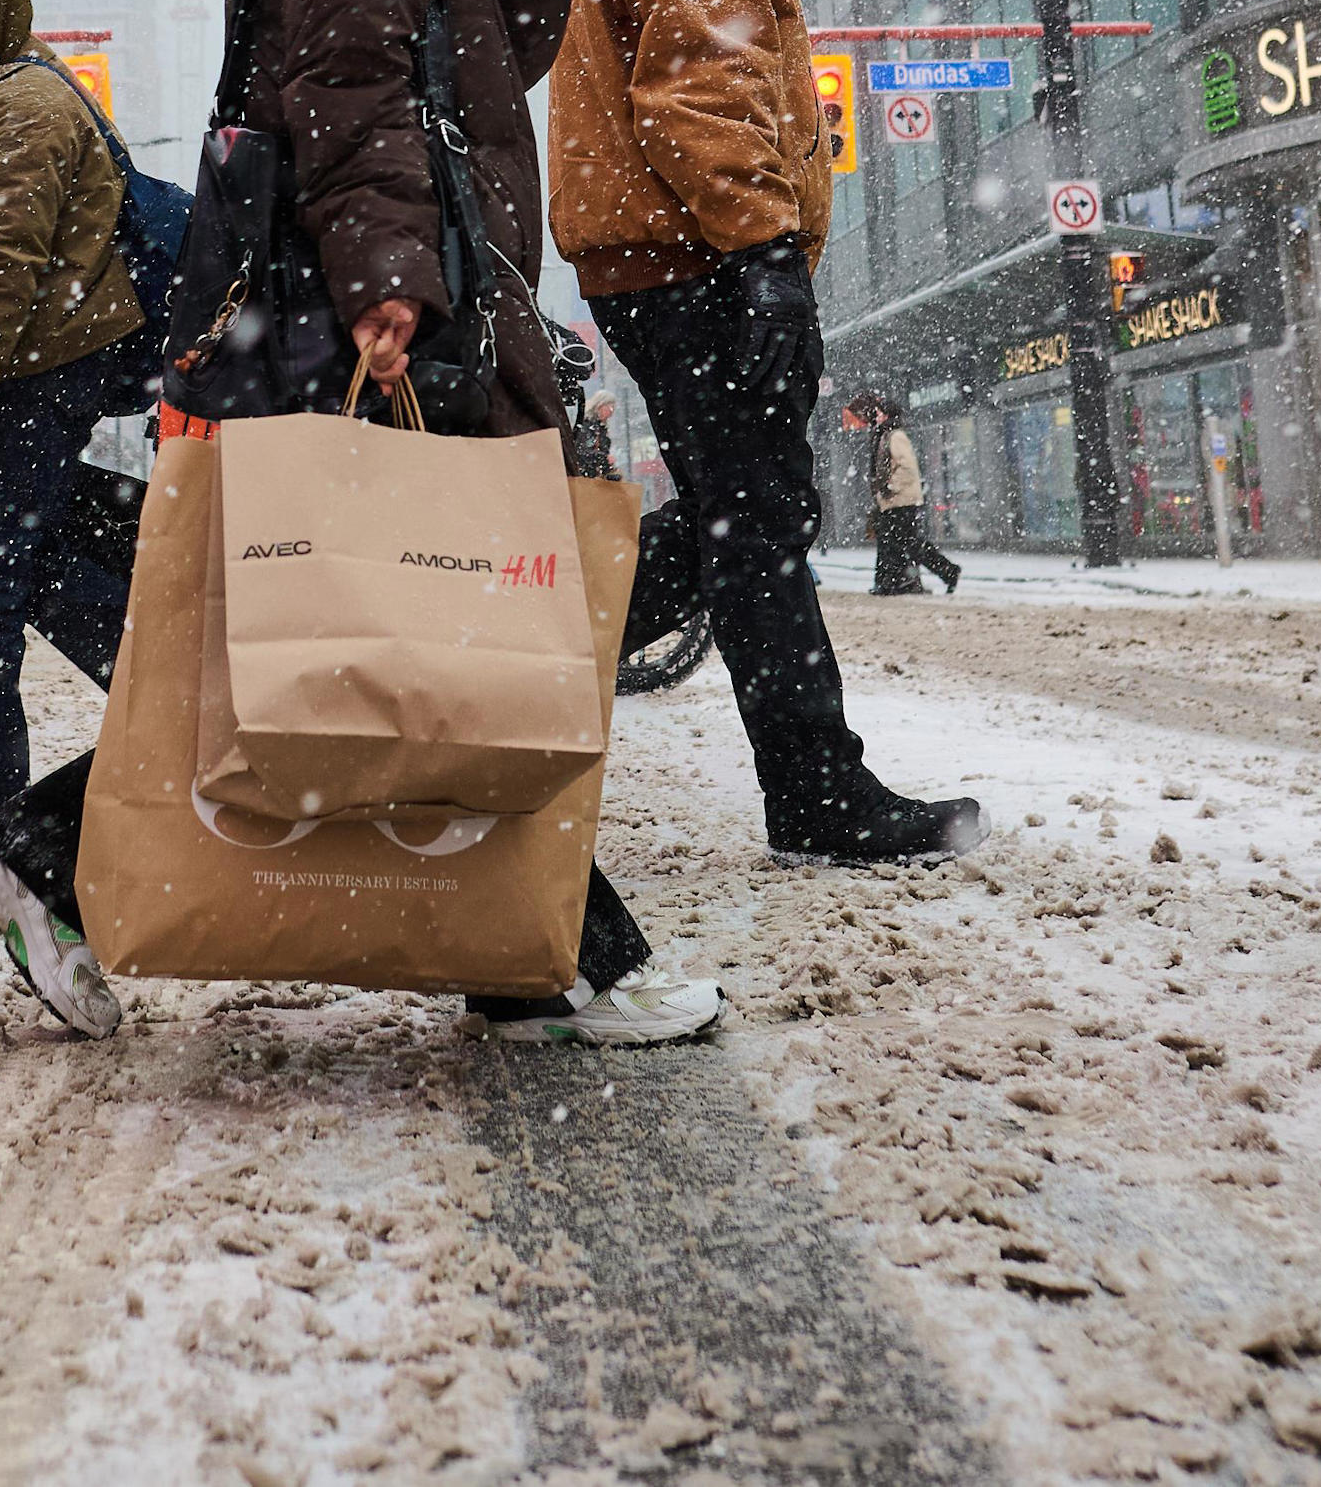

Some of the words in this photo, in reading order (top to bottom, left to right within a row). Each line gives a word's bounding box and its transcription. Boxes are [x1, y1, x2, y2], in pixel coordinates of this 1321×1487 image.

[893, 63, 970, 86] Dundas
[1128, 301, 1173, 348] SHAKE
[1171, 287, 1221, 337] SHACK
[242, 540, 313, 560] AVEC
[399, 551, 493, 573] AMOUR
[499, 553, 557, 589] H&M
[252, 871, 285, 886] THE
[285, 872, 393, 890] ANNIVERSARY
[432, 878, 459, 892] 1975
